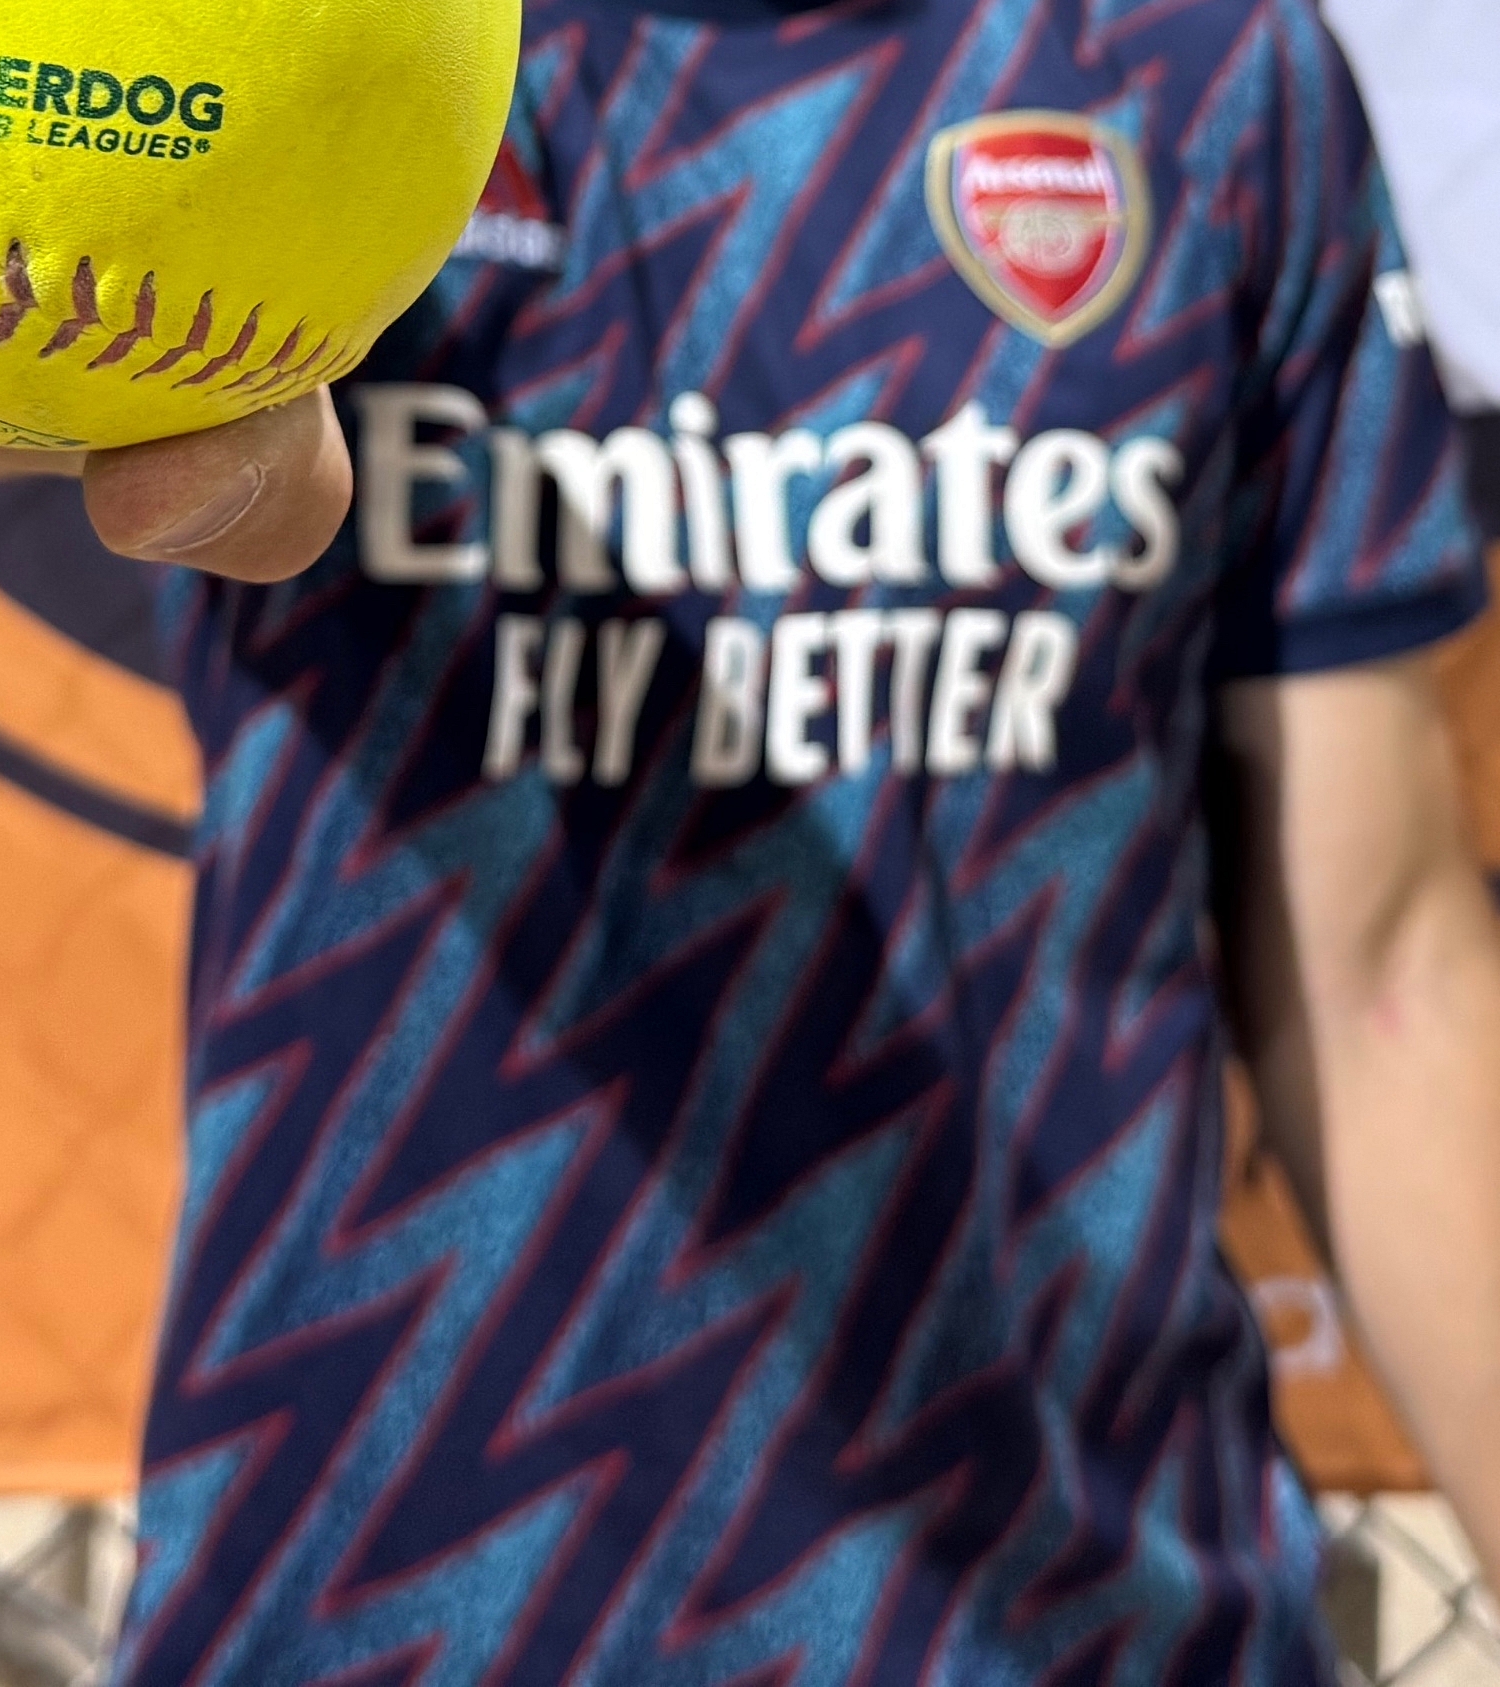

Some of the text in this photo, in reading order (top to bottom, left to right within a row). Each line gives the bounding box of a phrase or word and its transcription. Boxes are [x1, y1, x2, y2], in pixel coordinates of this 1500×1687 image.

[355, 384, 1183, 593] Emirates
[483, 608, 1079, 787] FLY BETTER
